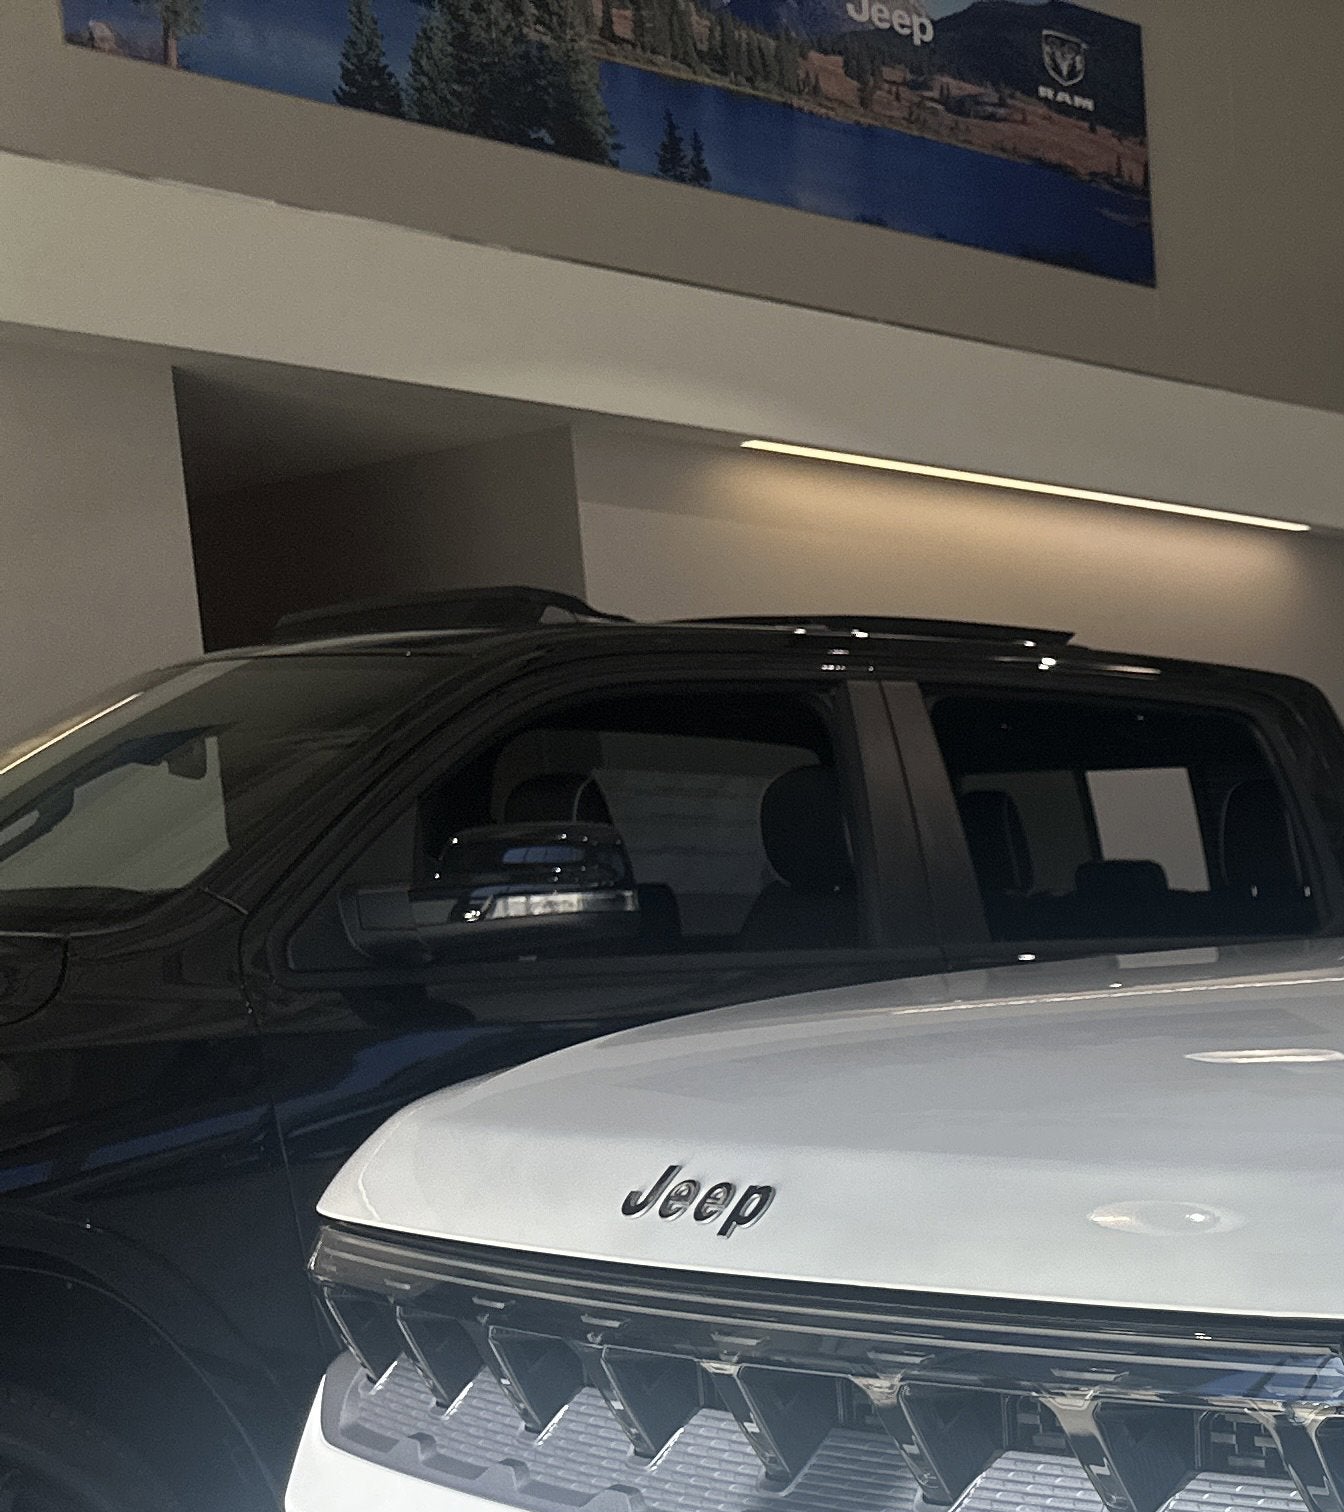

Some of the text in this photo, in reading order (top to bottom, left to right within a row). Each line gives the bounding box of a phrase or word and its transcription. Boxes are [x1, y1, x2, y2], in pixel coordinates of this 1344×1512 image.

[847, 0, 935, 46] Jeep
[1037, 85, 1096, 112] RAM
[621, 1164, 776, 1239] Jeep
